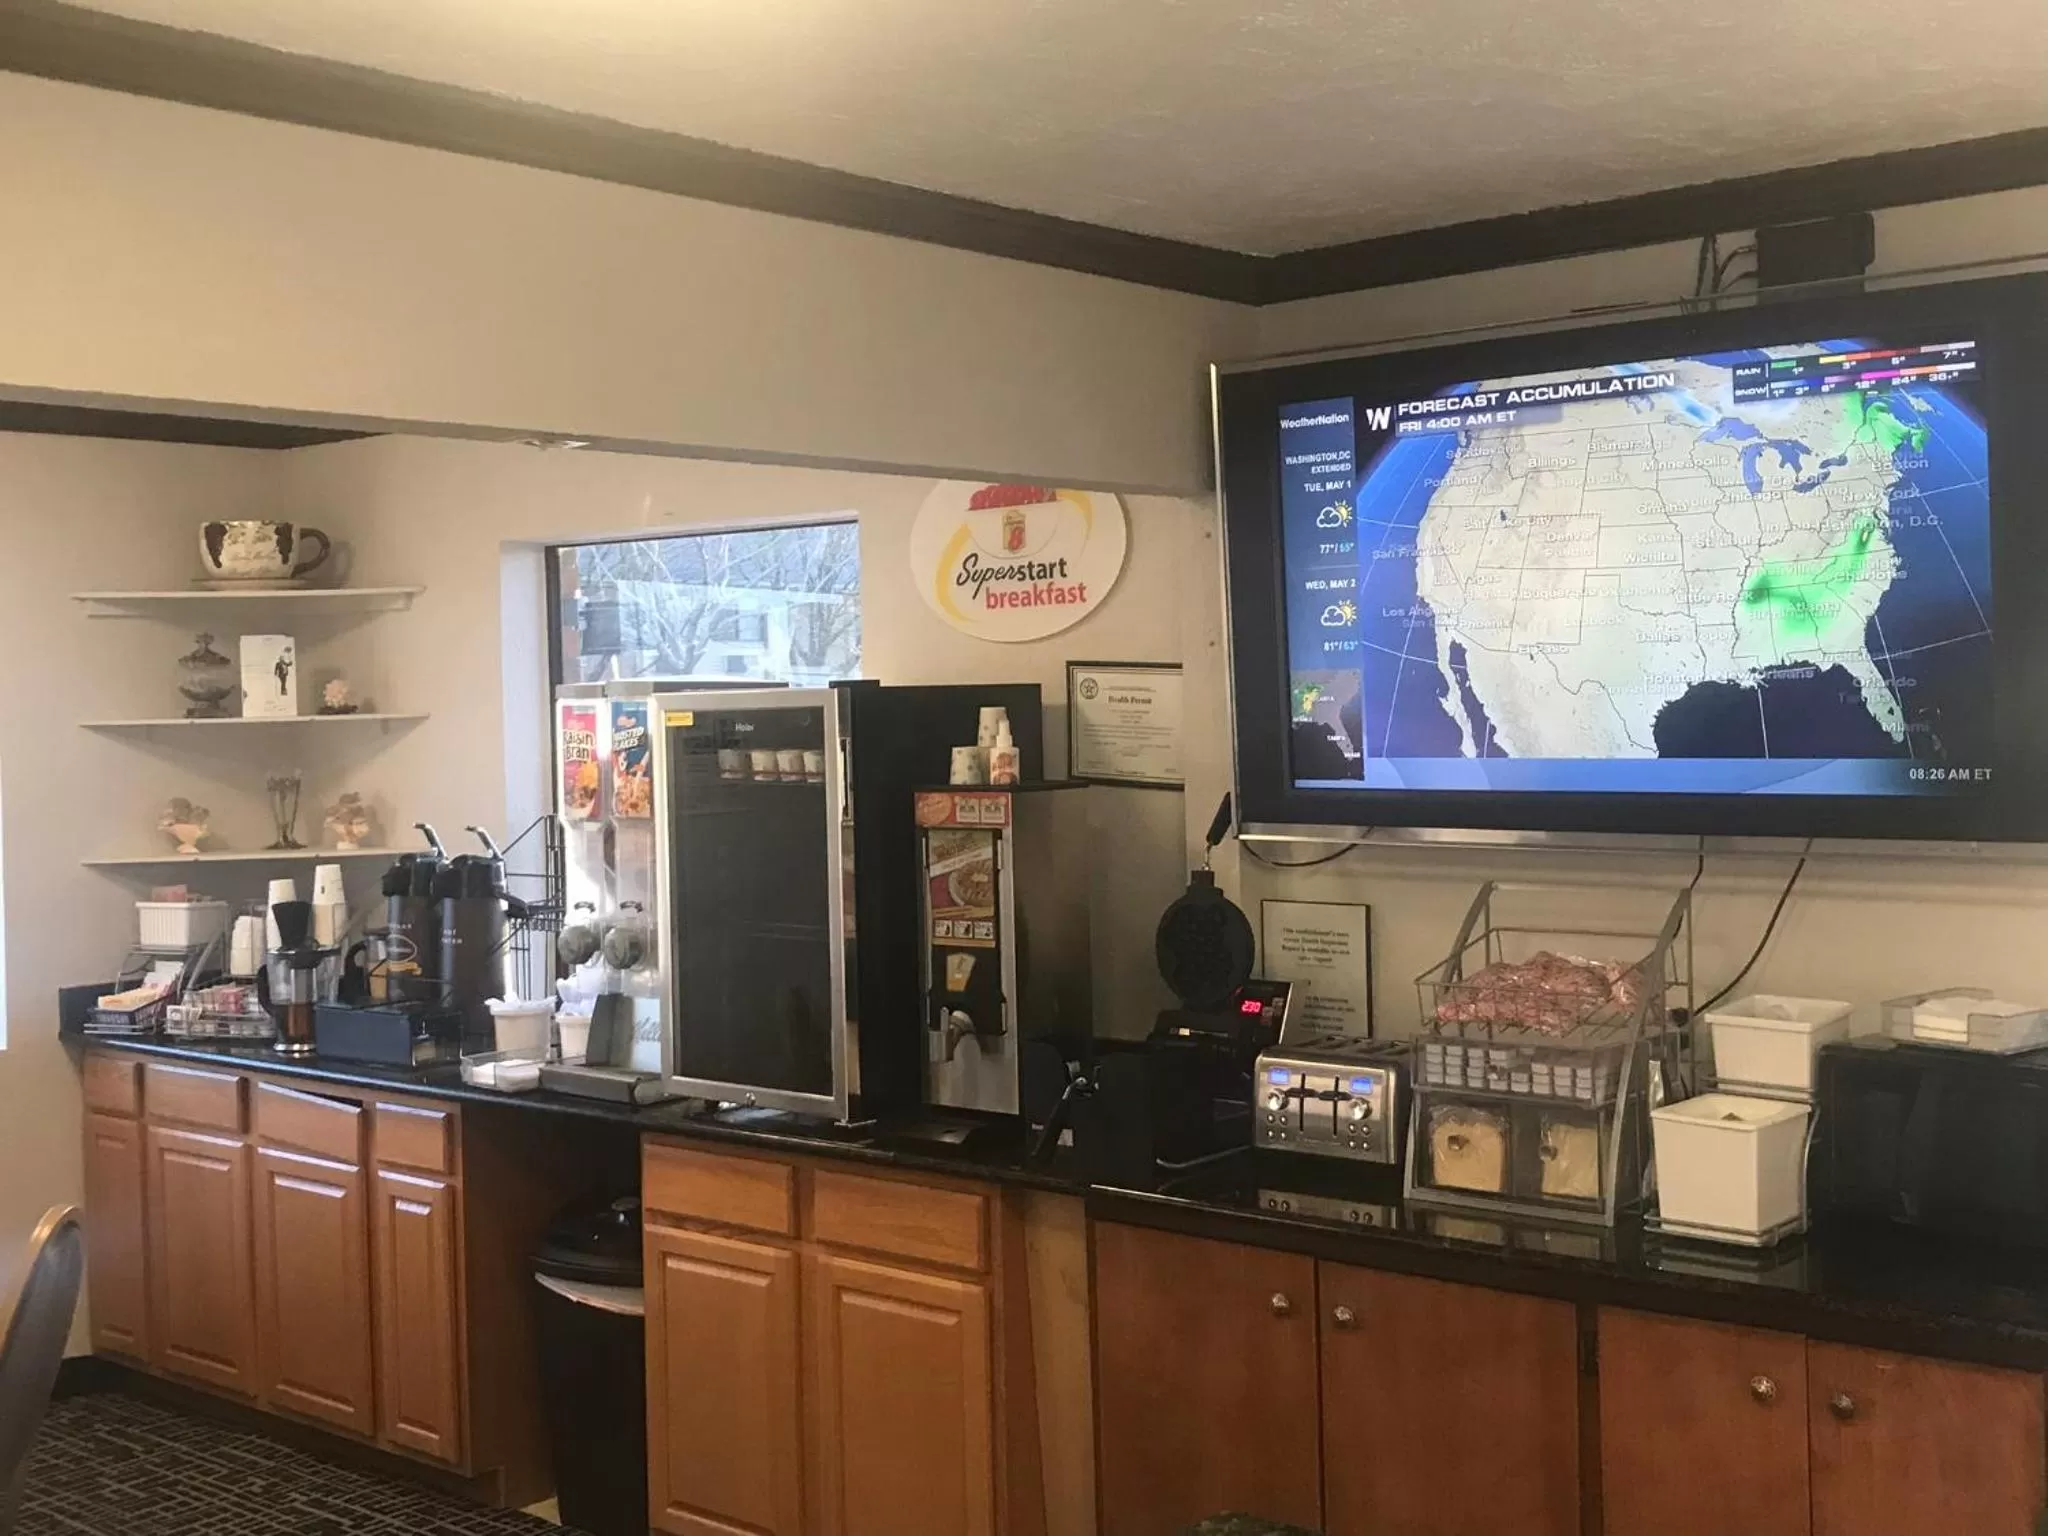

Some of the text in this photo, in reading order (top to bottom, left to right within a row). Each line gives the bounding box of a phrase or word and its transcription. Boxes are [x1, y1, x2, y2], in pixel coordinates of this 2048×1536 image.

[1736, 367, 1762, 377] RAIN
[1397, 372, 1676, 417] FORECAST ACCUMULATION
[1734, 387, 1766, 398] SNOW
[1280, 412, 1350, 430] WeatherNation
[1399, 410, 1518, 433] FRI 4:00 AM ET
[1310, 463, 1352, 475] EXTENDED
[1527, 455, 1577, 470] Billings
[1640, 454, 1730, 473] Minneapolis
[1303, 480, 1353, 495] TUE, MAY 1
[1720, 489, 1782, 504] Chicago
[956, 553, 1069, 601] Superstart
[1305, 578, 1357, 592] WED, MAY 2
[984, 580, 1089, 611] breakfast
[1382, 607, 1406, 619] Los
[1852, 676, 1919, 689] Orlando
[1909, 768, 1994, 781] 08:26 AM ET
[1240, 1000, 1262, 1014] 230
